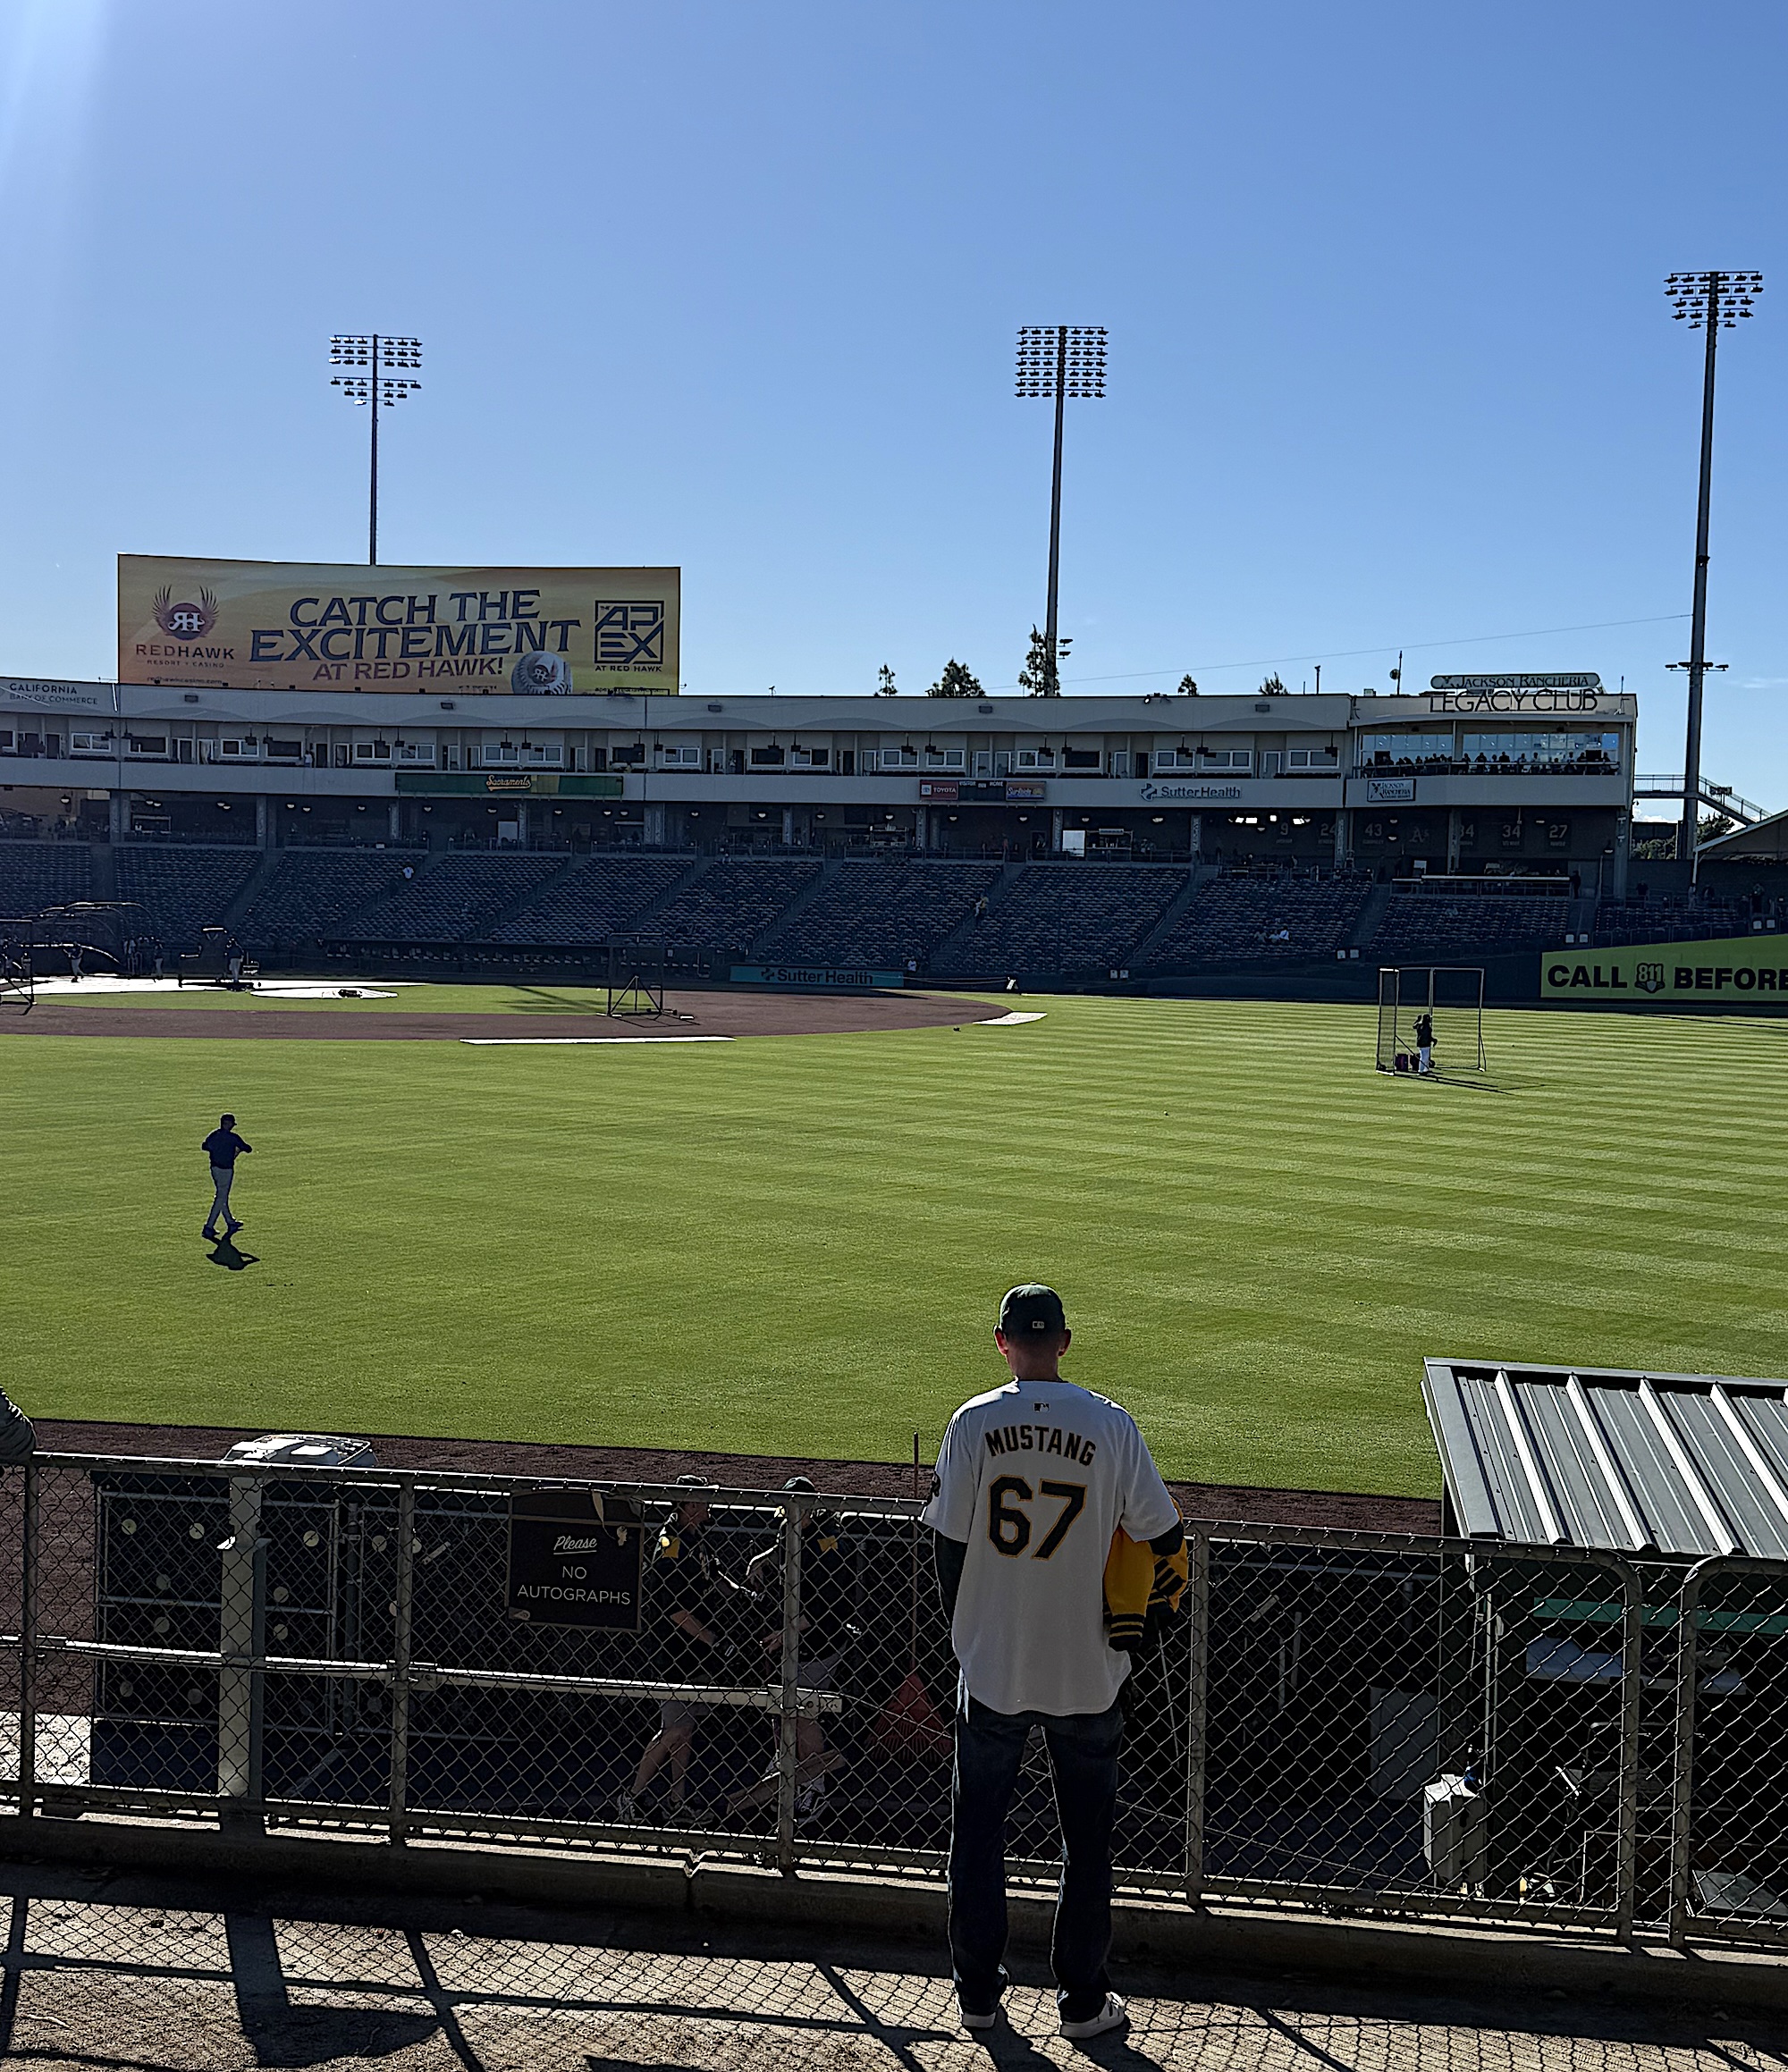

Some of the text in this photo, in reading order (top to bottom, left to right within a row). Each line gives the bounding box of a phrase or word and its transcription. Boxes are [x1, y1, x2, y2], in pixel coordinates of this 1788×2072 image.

[290, 590, 541, 627] CATCH THE
[249, 619, 582, 662] EXCITEMENT
[313, 657, 503, 680] AT RED HAWK!
[10, 683, 78, 695] CALIFORNIA
[1457, 675, 1589, 688] JACKSON RANCHERIA
[48, 695, 98, 705] COMMERCE
[1430, 688, 1598, 712] LEGACY CLUB
[485, 774, 532, 788] Sacramento
[1161, 786, 1241, 798] Sutter Health
[1279, 822, 1289, 836] 9
[1364, 823, 1383, 837] 43
[1502, 824, 1521, 838] 34
[1548, 824, 1568, 838] 27
[777, 969, 873, 985] Sutter Health
[1548, 964, 1628, 989] CALL
[1637, 964, 1664, 983] 811
[984, 1425, 1097, 1467] MUSTANG
[987, 1474, 1088, 1561] 67
[552, 1535, 598, 1551] Please
[561, 1565, 587, 1579] NO
[517, 1584, 631, 1605] AUTOGRAPHS
